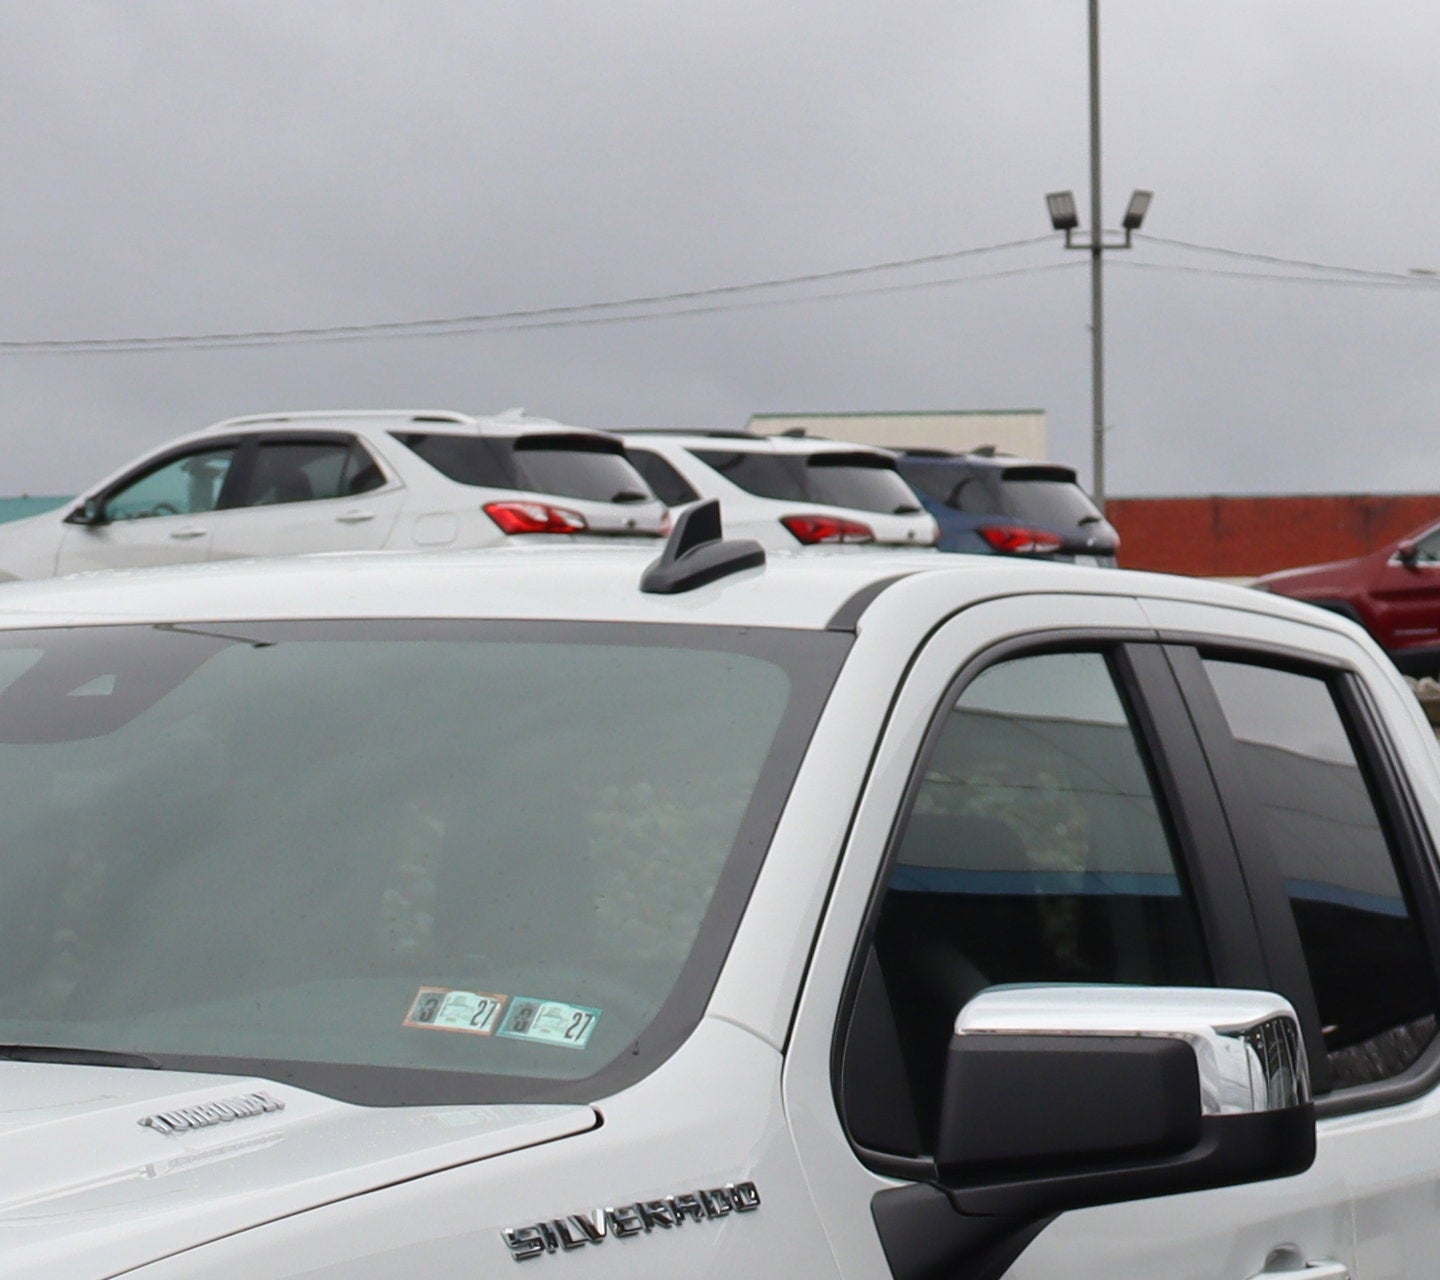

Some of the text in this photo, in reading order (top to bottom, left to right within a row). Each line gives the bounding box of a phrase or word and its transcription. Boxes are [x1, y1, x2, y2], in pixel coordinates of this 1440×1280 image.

[470, 999, 499, 1030] 27
[564, 1011, 595, 1042] 27
[500, 1180, 762, 1262] SILVERADO
